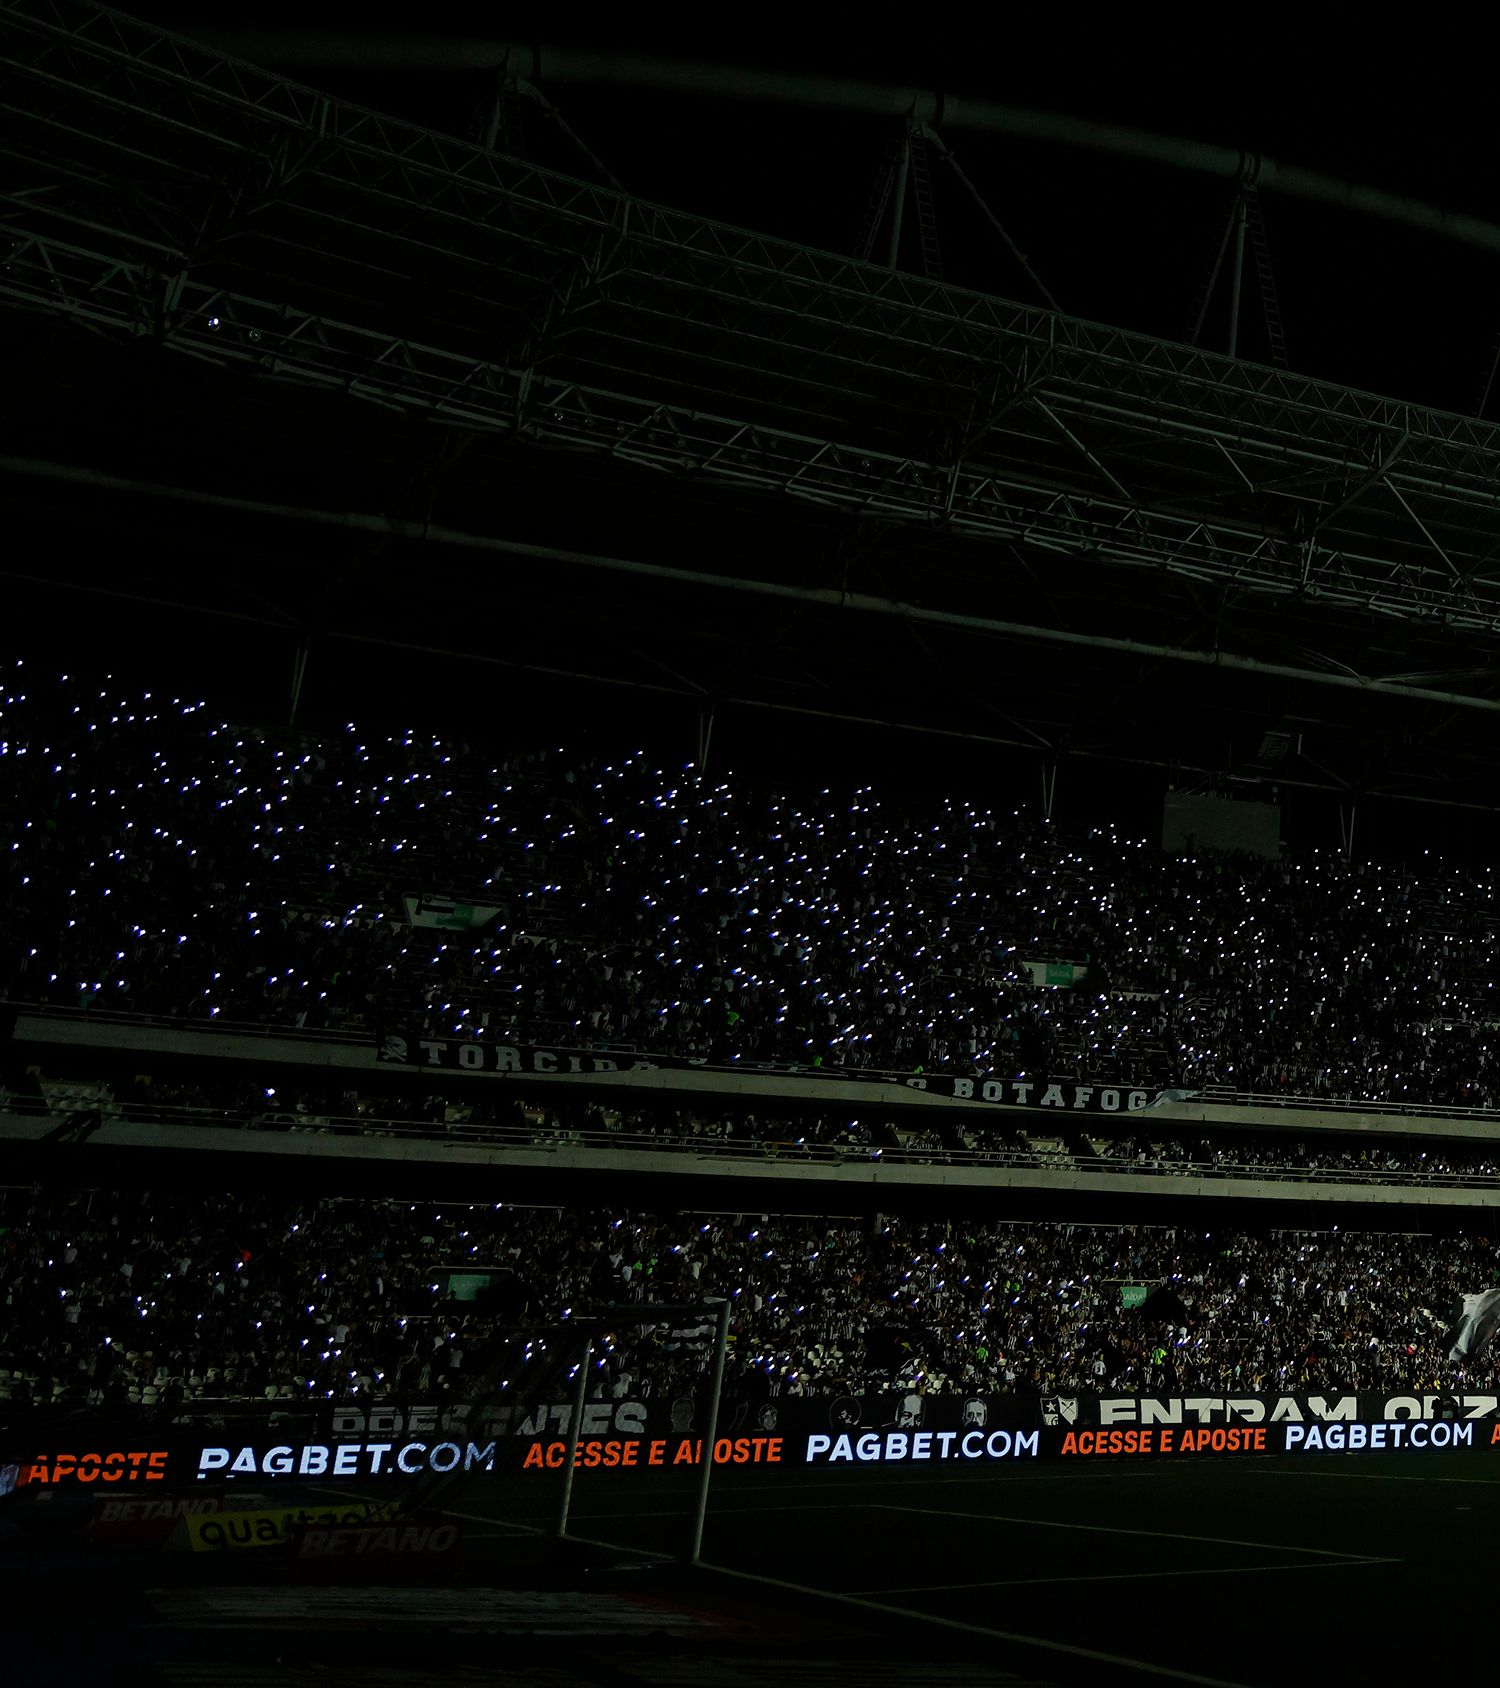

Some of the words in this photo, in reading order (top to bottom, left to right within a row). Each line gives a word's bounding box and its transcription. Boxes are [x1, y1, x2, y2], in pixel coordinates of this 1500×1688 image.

[953, 1078, 1162, 1113] BOTAFOG
[1098, 1396, 1358, 1425] ENTRAM
[648, 1440, 667, 1466] E
[673, 1437, 784, 1466] AOSTE
[806, 1430, 1040, 1462] PAGBET.COM
[1061, 1430, 1152, 1455] ACESSE
[1159, 1429, 1175, 1453] E
[1179, 1427, 1267, 1452] APOSTE
[1285, 1422, 1473, 1451] PAGBET.COM
[196, 1441, 495, 1480] PAGBET.COM
[299, 1523, 460, 1558] BETANO
